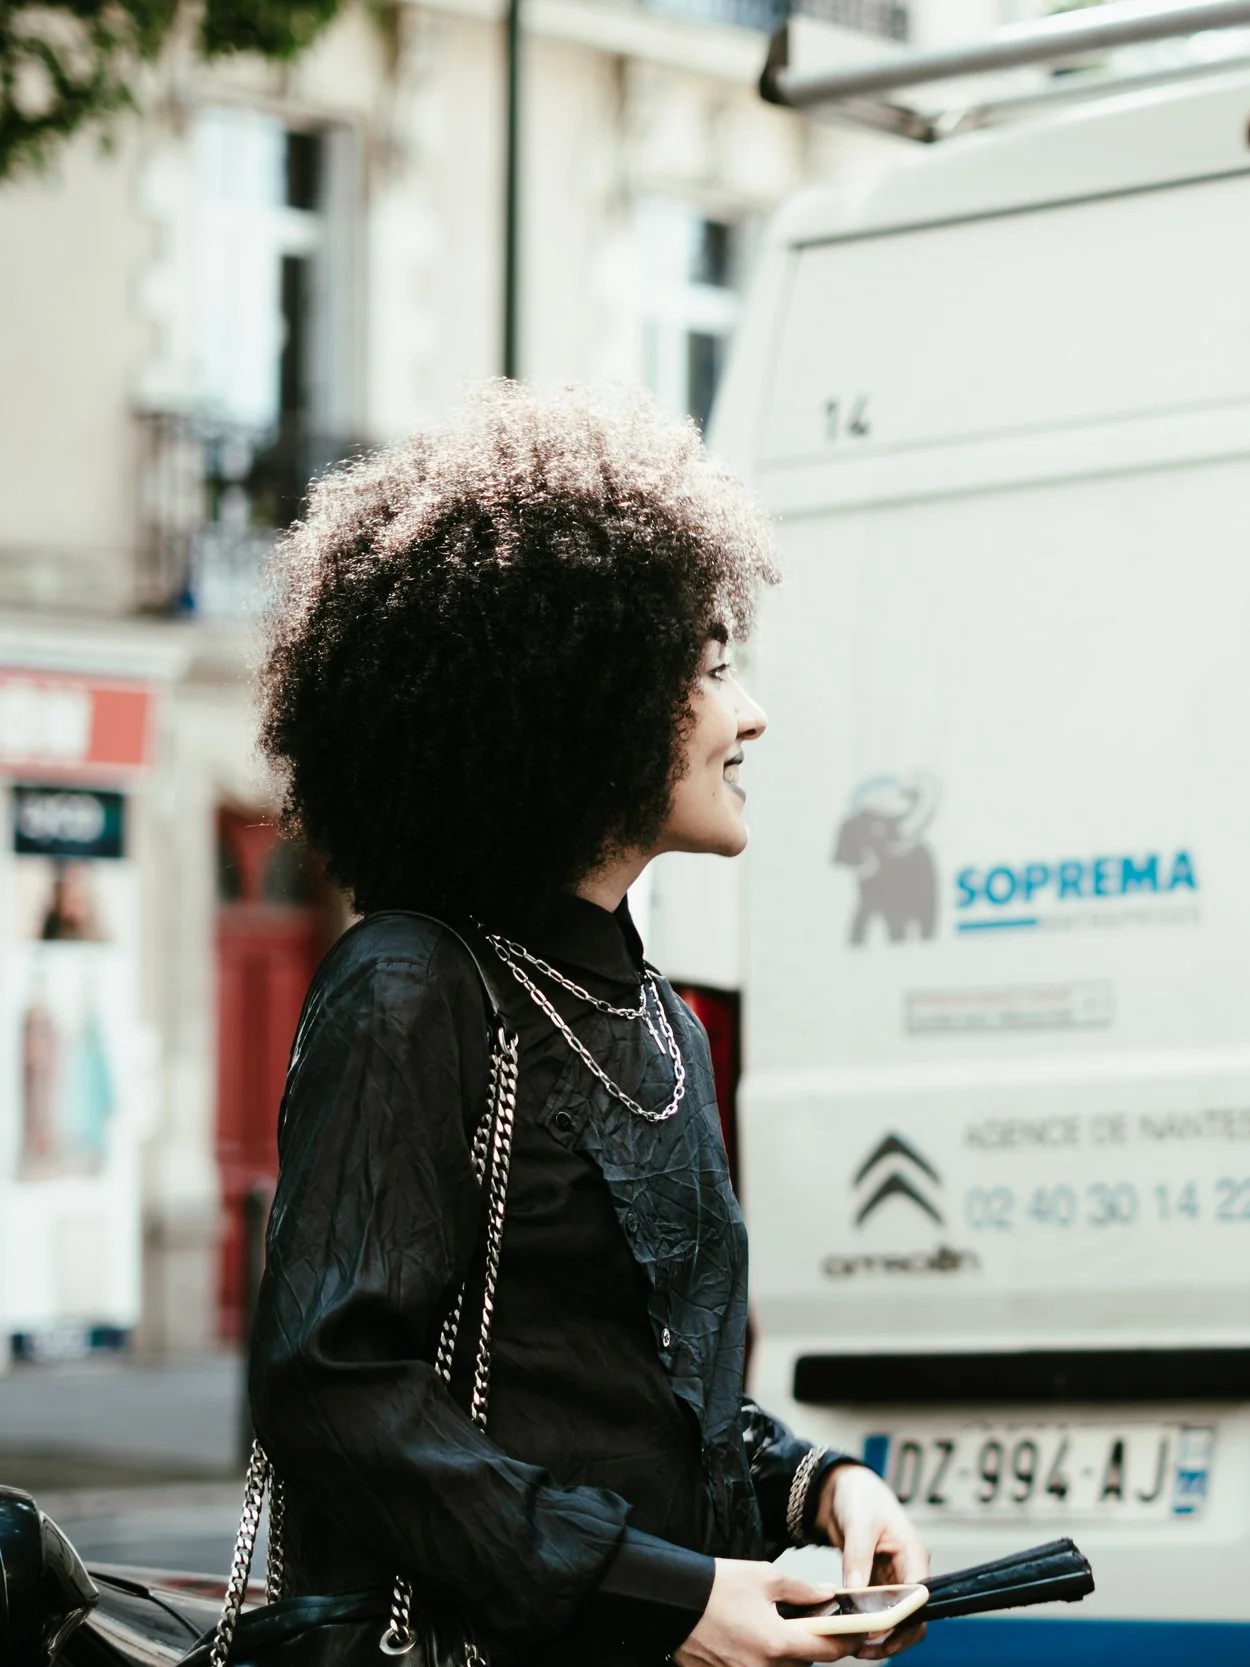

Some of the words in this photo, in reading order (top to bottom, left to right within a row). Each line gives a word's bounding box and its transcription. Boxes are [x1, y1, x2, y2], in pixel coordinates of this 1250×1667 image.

[823, 393, 872, 441] 14
[955, 848, 1199, 908] SOPREMA
[964, 1113, 1081, 1149] AGENCE
[1093, 1111, 1128, 1145] DE
[964, 1186, 1015, 1230] 02
[1027, 1183, 1077, 1228] 40
[1087, 1182, 1139, 1227] 30
[1154, 1179, 1200, 1221] 14
